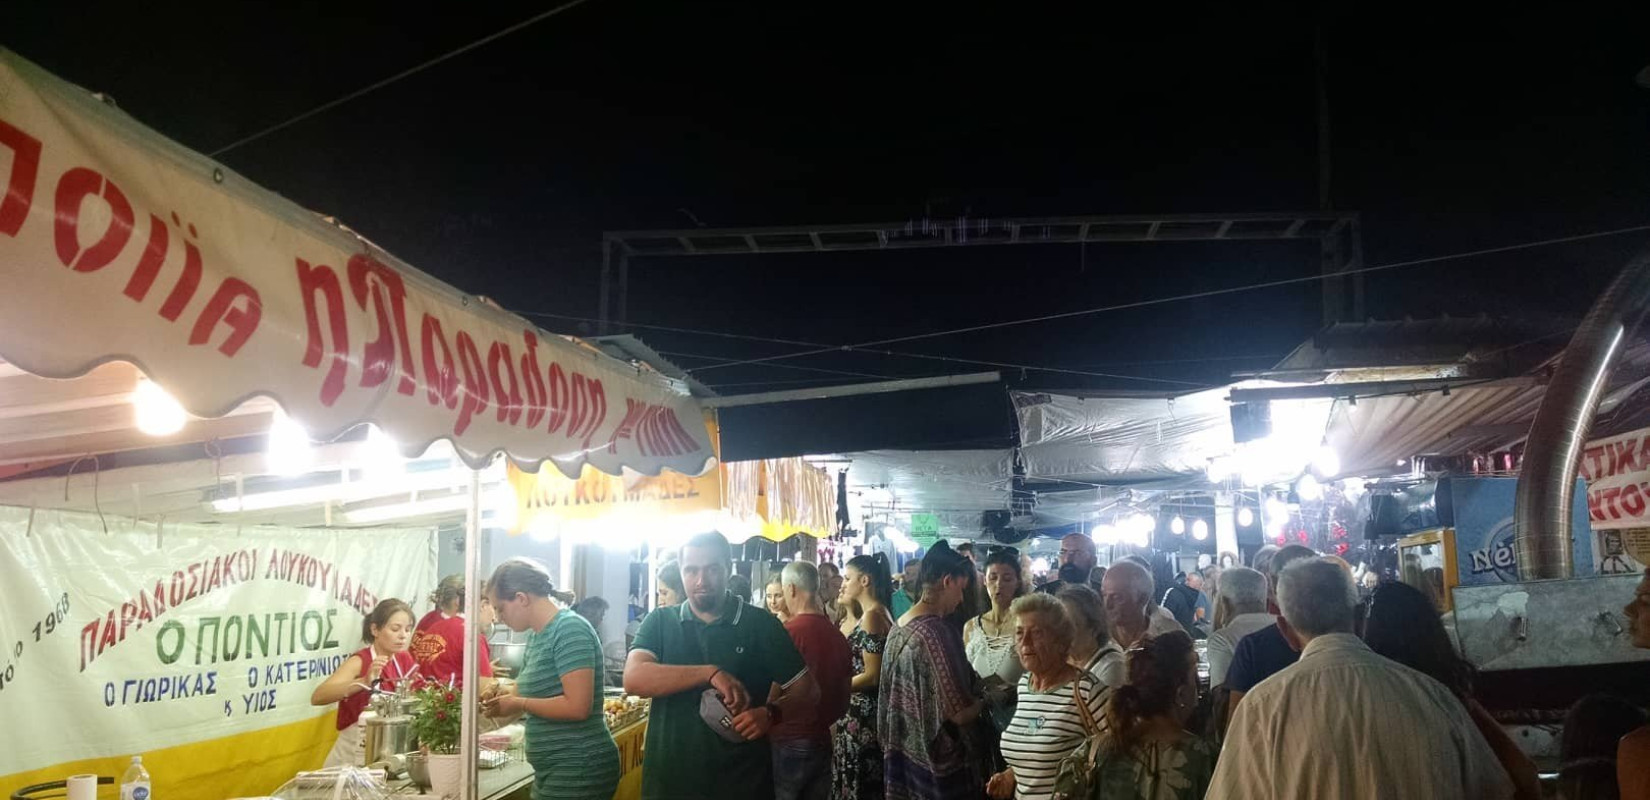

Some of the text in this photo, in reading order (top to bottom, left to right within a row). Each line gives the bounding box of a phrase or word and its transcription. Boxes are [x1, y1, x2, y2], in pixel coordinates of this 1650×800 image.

[32, 591, 70, 643] 1968
[195, 608, 339, 666] ΠΟΝΤΙΟΣ
[121, 671, 219, 706] ΓΙΩΡΙΚΑΣ
[242, 688, 278, 715] ΥΙΟΣ
